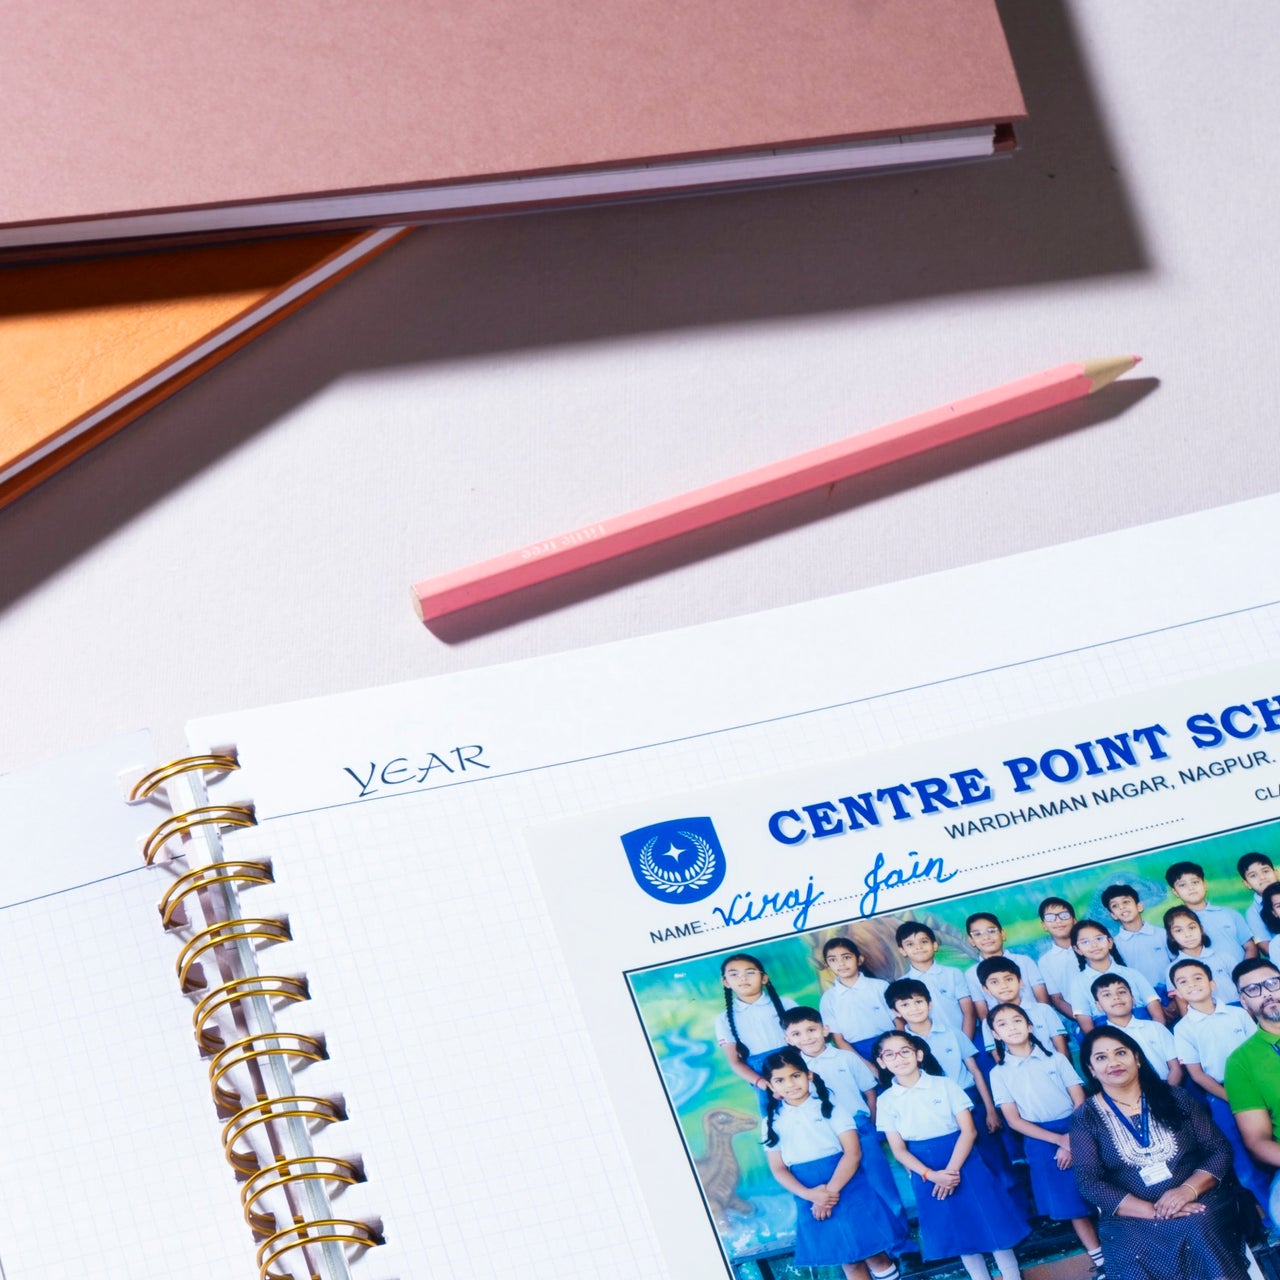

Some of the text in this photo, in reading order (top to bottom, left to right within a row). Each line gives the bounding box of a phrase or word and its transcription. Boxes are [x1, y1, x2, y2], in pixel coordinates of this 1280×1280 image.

[342, 744, 491, 798] YEAR
[768, 768, 993, 845] CENTRE
[1003, 724, 1169, 793] POINT
[944, 751, 1275, 839] WARDHAMAN NAGAR, NAGPUR.
[712, 851, 959, 930] Viraj Jain
[650, 921, 704, 943] NAME:
